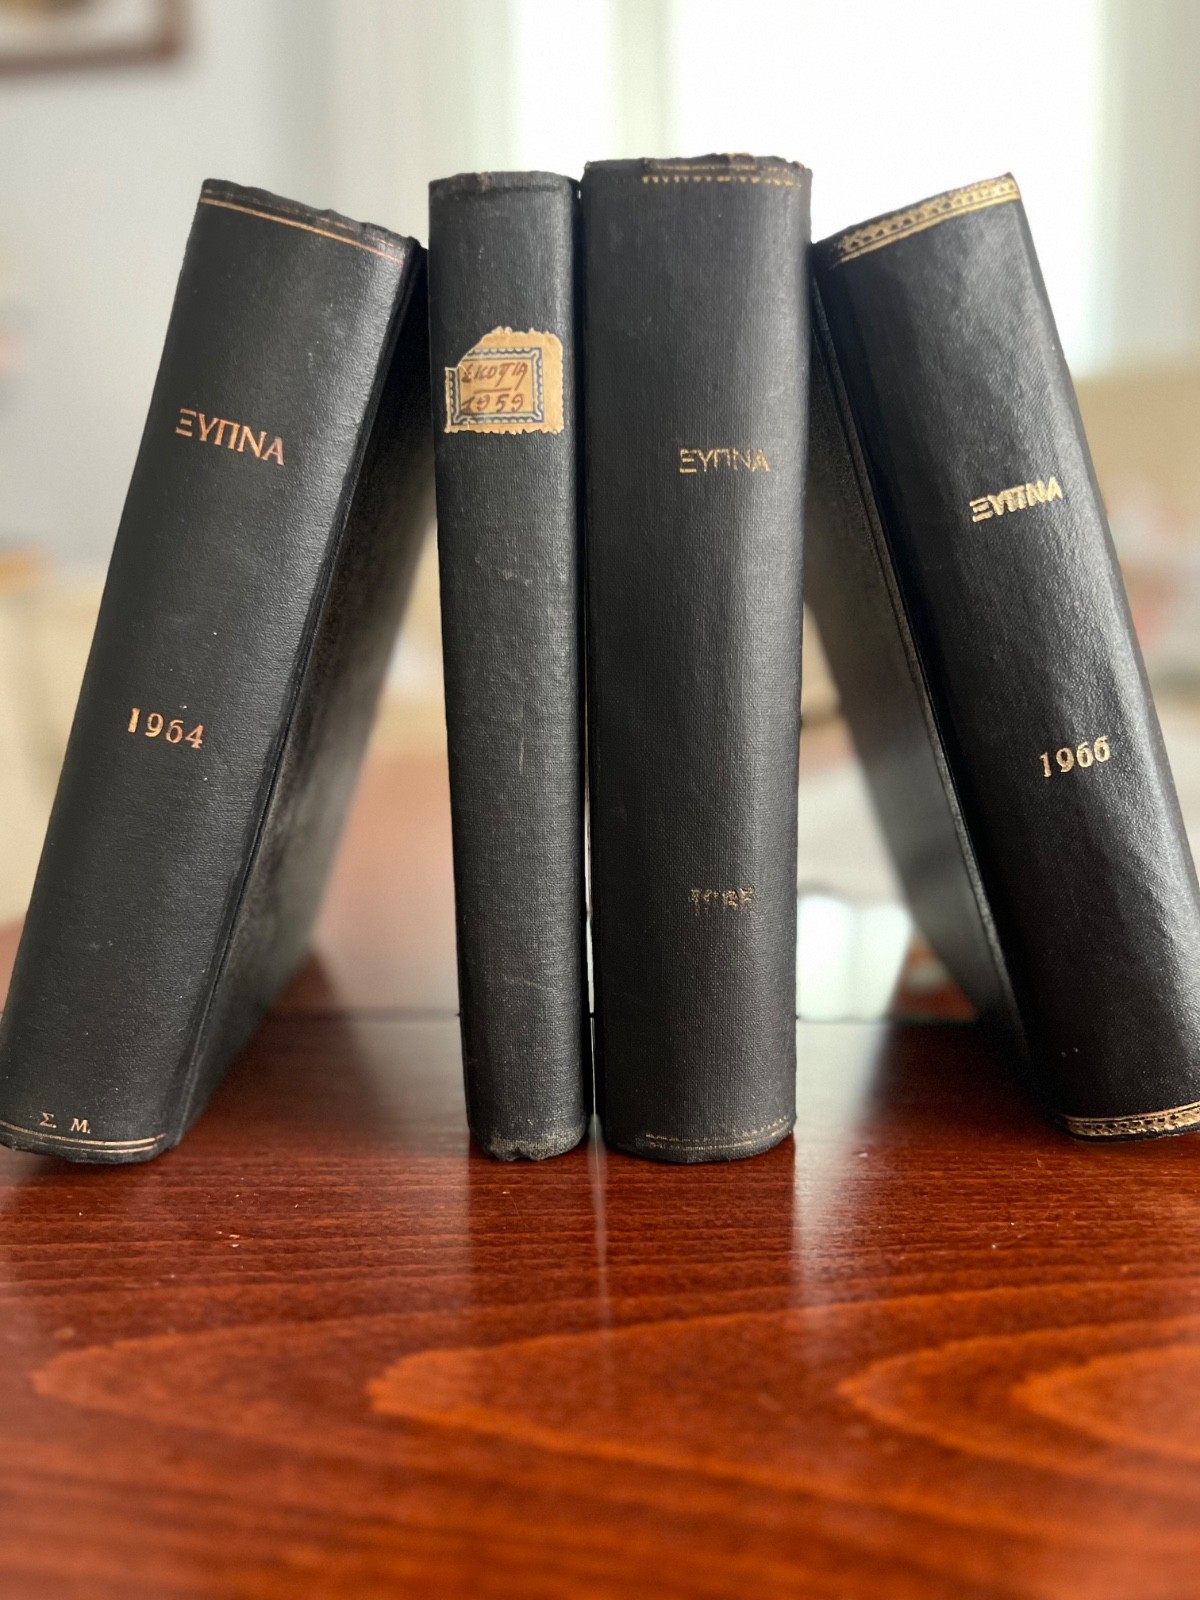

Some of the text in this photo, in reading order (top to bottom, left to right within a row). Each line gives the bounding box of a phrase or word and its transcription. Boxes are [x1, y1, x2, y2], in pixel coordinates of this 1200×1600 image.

[175, 407, 285, 466] ΞΥΠΝΑ
[679, 447, 771, 473] ΞΥΠΝΑ
[969, 475, 1064, 523] ΞΥΠΝΑ
[127, 707, 204, 749] 1964
[1039, 734, 1111, 778] 1966
